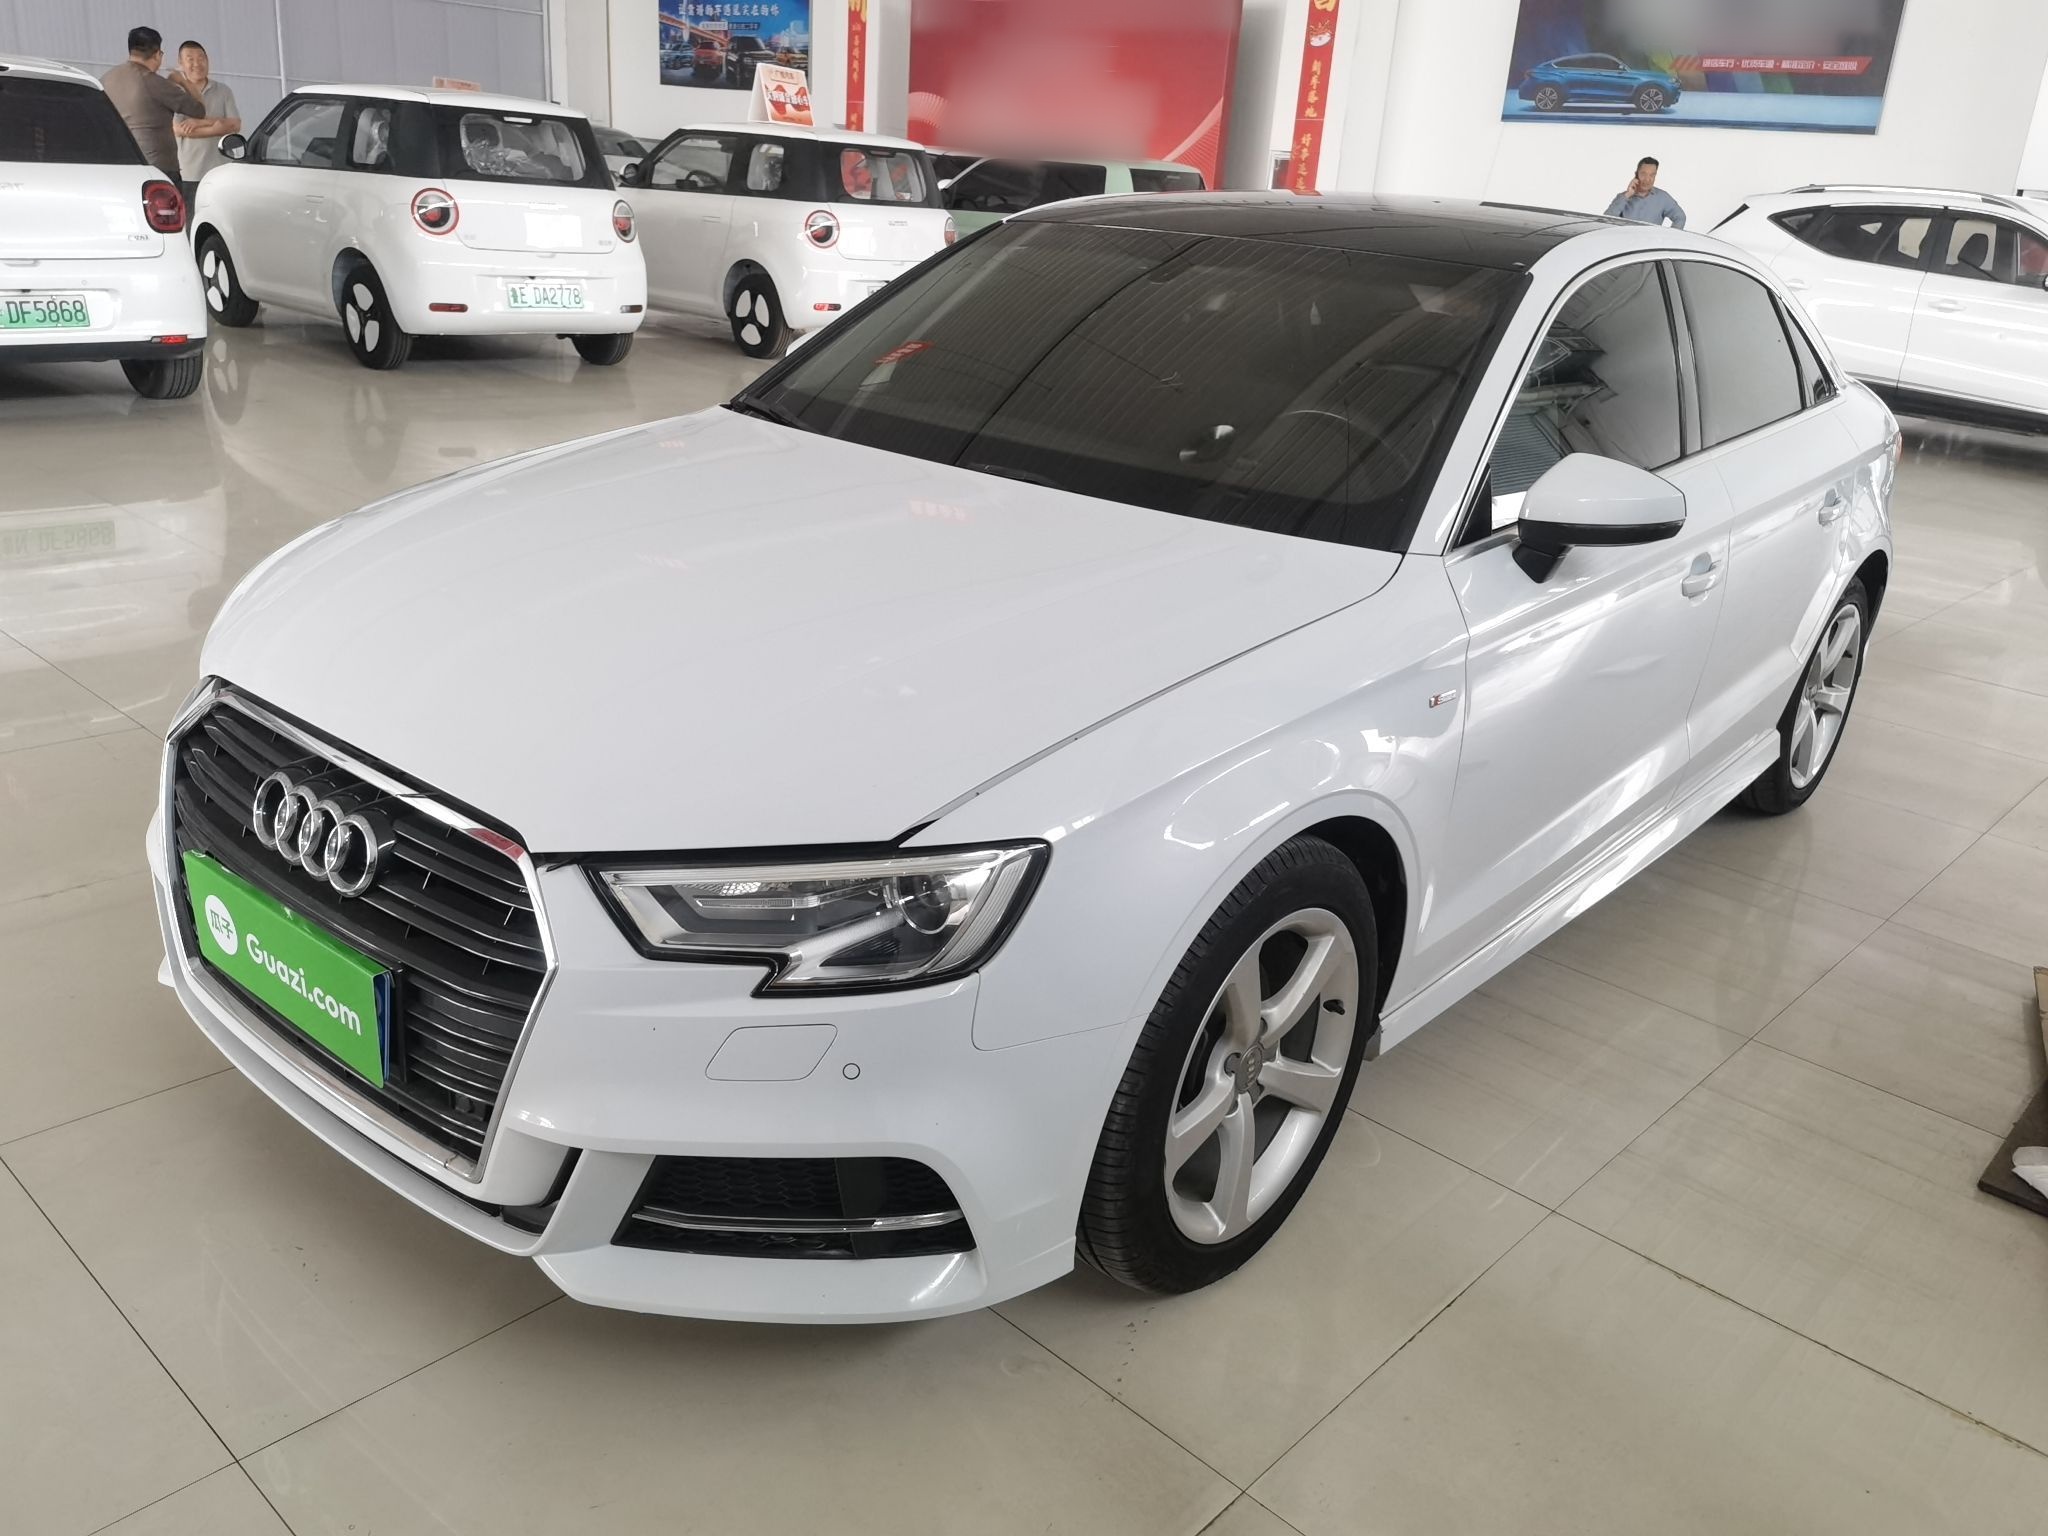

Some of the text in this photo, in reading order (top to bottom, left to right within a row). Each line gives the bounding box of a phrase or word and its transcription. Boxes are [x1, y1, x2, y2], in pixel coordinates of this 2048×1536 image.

[533, 286, 582, 306] DA2778
[5, 299, 87, 324] DF5868
[209, 908, 234, 941] 瓜子
[245, 932, 362, 1036] Guazi.com
